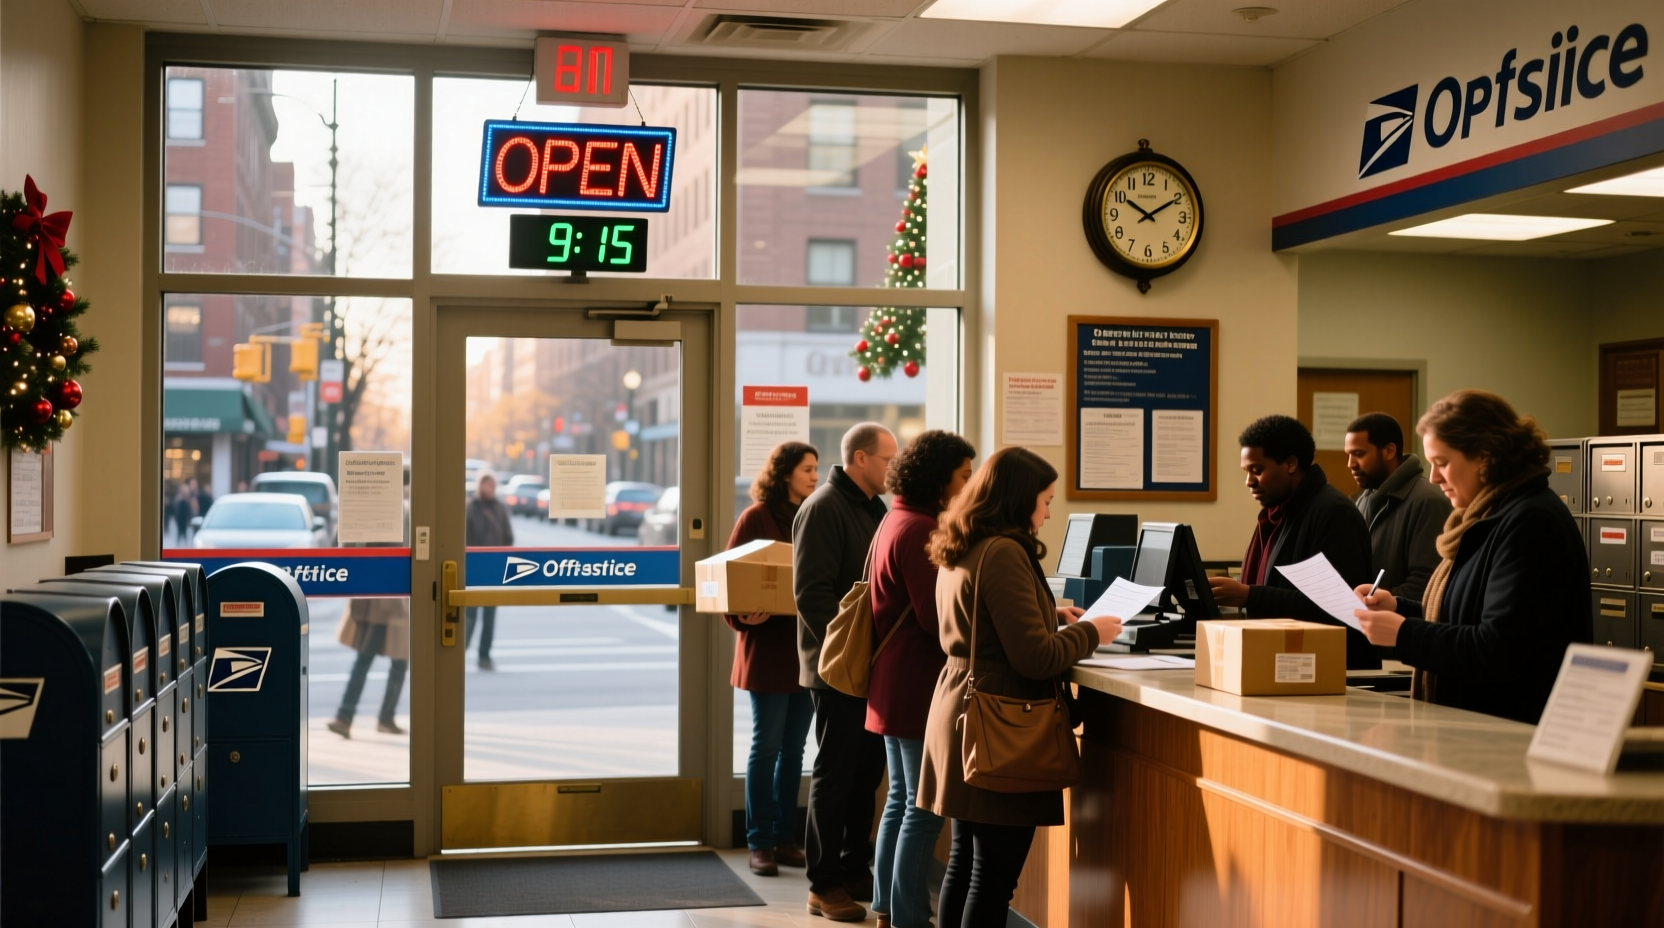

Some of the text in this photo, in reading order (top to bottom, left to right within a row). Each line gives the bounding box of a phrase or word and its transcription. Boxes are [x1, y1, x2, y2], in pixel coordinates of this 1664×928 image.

[495, 136, 661, 197] OPEN
[1128, 177, 1135, 190] 11
[1143, 173, 1155, 186] 12
[1115, 191, 1126, 203] 10
[1174, 193, 1182, 204] 2
[1110, 208, 1118, 221] 9
[1178, 211, 1186, 224] 3
[1115, 226, 1123, 239] 8
[1173, 229, 1181, 241] 4
[547, 223, 634, 264] 9:15
[1128, 239, 1135, 252] 7
[1162, 241, 1169, 253] 5
[1145, 245, 1152, 257] 6
